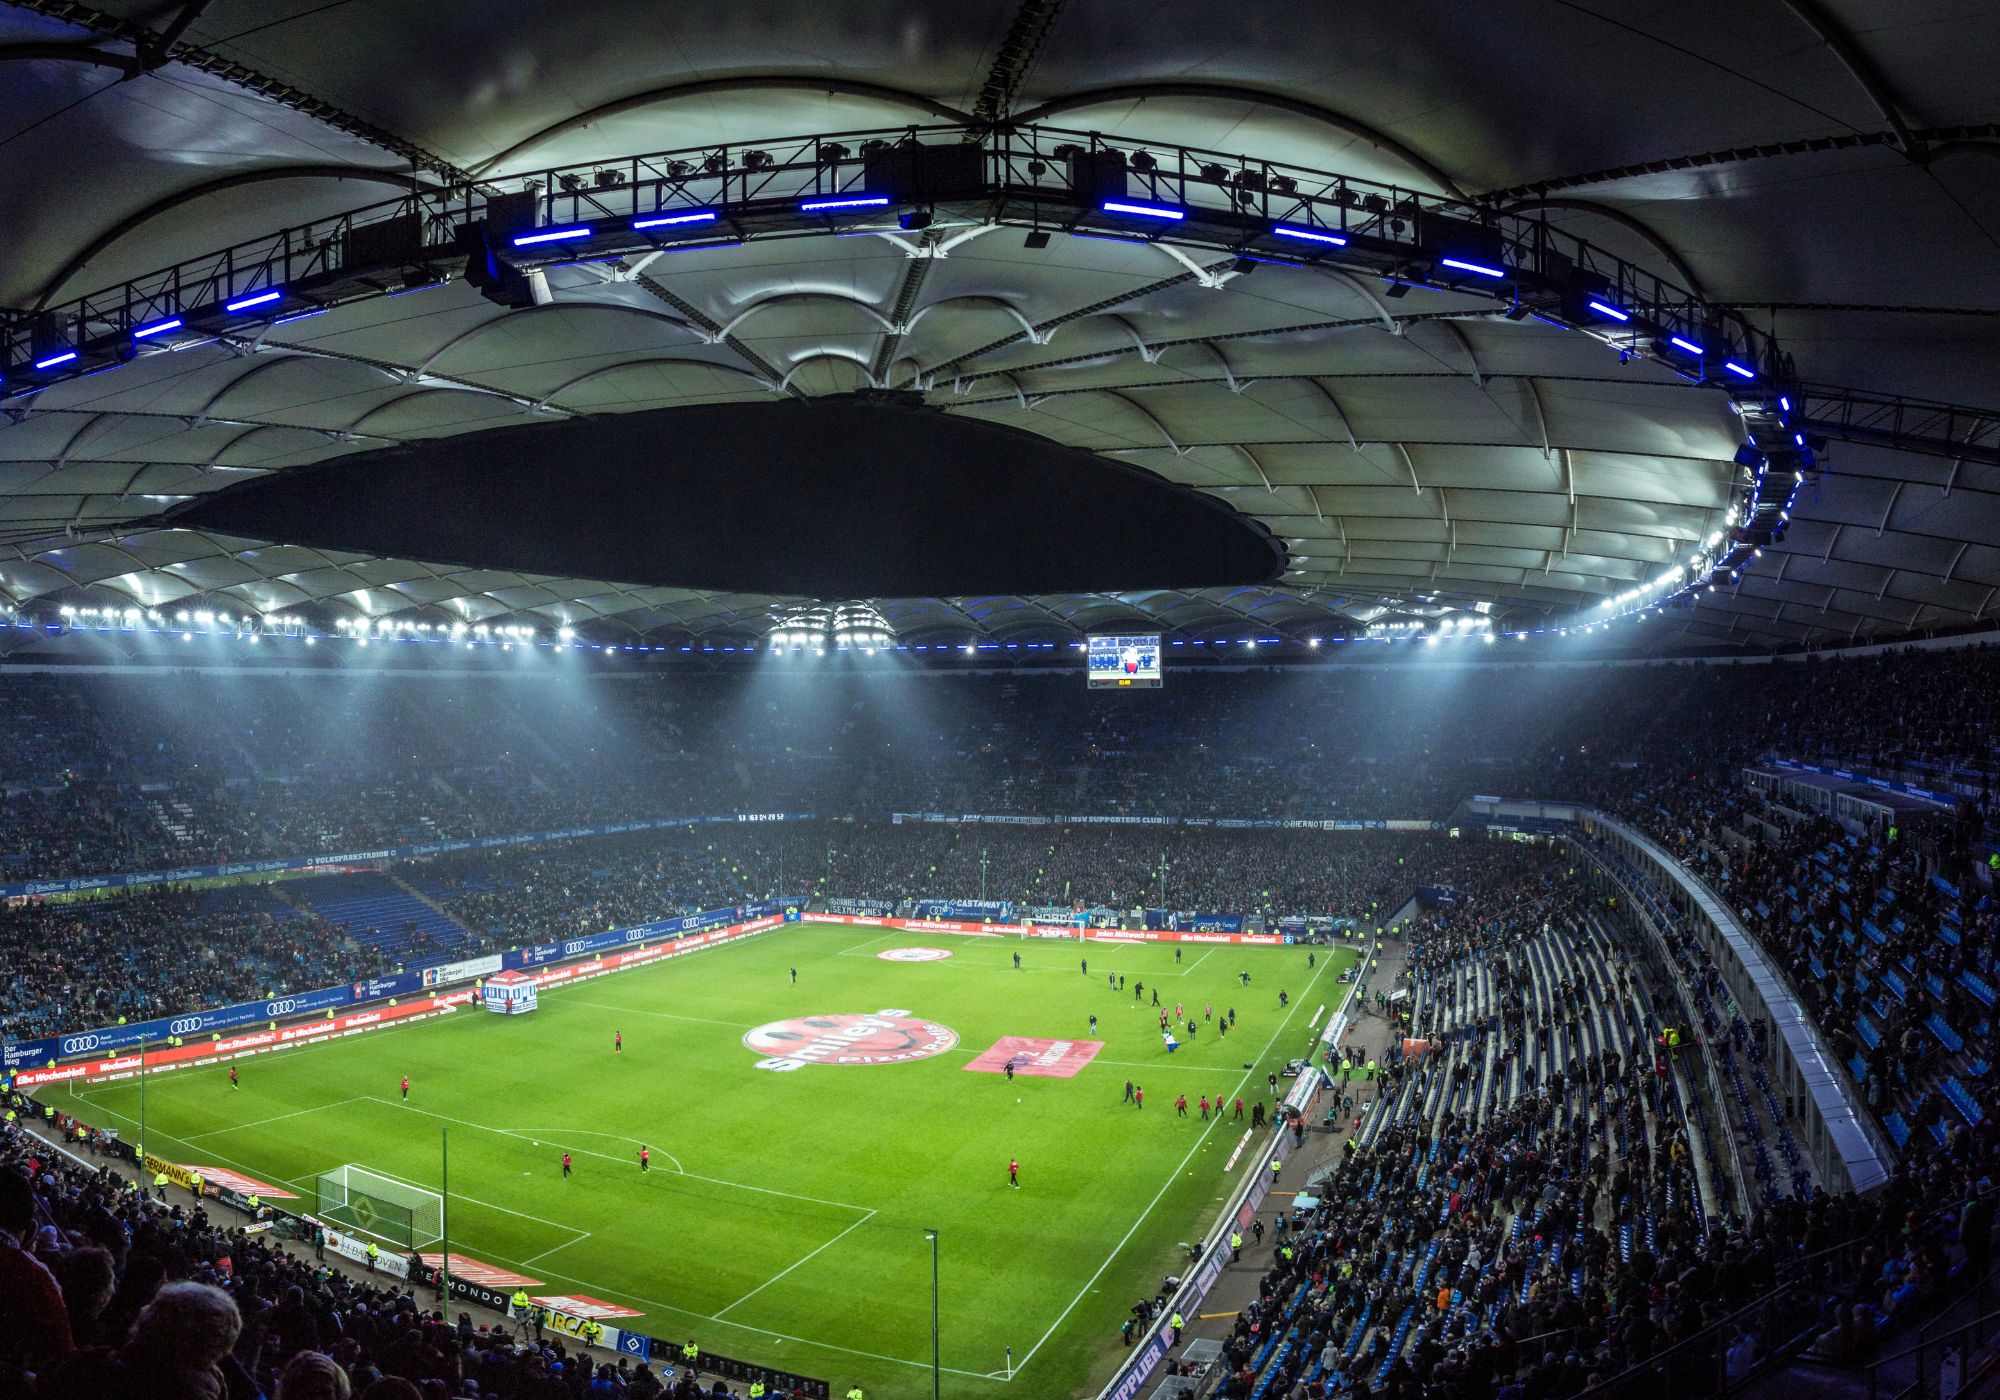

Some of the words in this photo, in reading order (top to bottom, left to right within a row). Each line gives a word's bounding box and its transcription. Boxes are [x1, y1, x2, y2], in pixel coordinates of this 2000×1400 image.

[1088, 816, 1141, 824] SUPPORTERS
[1142, 816, 1163, 824] CLUB
[315, 850, 389, 865] VOLKSPARKSTADION
[836, 898, 857, 907] DANIEL
[867, 899, 884, 909] TOUR
[956, 900, 1001, 909] CASTAWAY
[4, 1047, 43, 1060] Hamburger
[4, 1058, 20, 1066] Weg
[16, 1075, 35, 1085] Elbe
[35, 1066, 86, 1082] Wochenblatt
